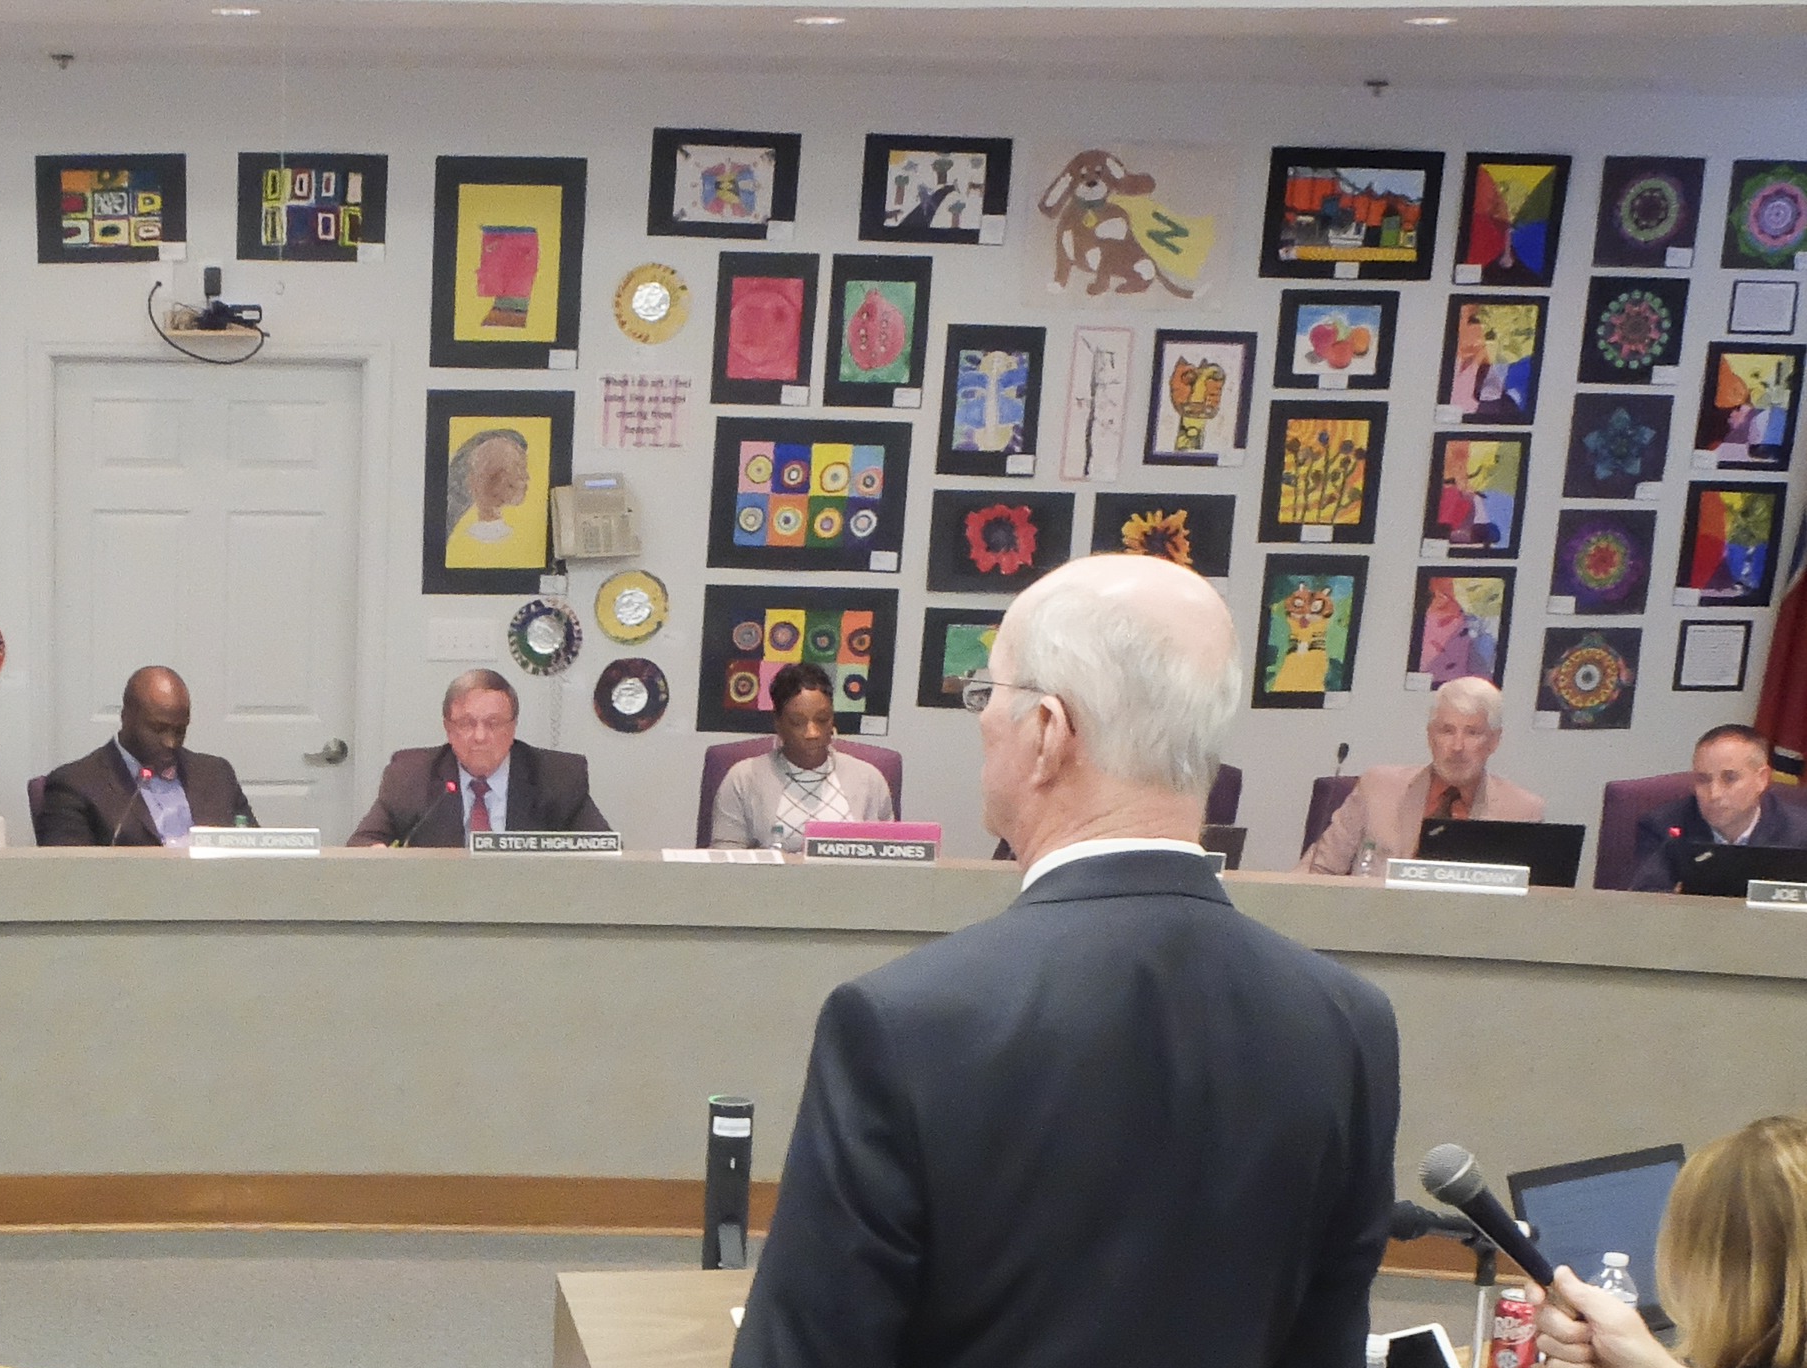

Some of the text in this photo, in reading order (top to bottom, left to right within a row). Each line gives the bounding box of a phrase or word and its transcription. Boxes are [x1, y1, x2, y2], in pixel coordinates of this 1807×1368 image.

[218, 834, 257, 847] BRYAN
[260, 835, 315, 848] JOHNSON
[475, 837, 617, 850] DR. STEVE HIGHLANDER
[817, 842, 926, 859] KARITSA JONES
[1399, 865, 1519, 885] JOE GALLOWAY
